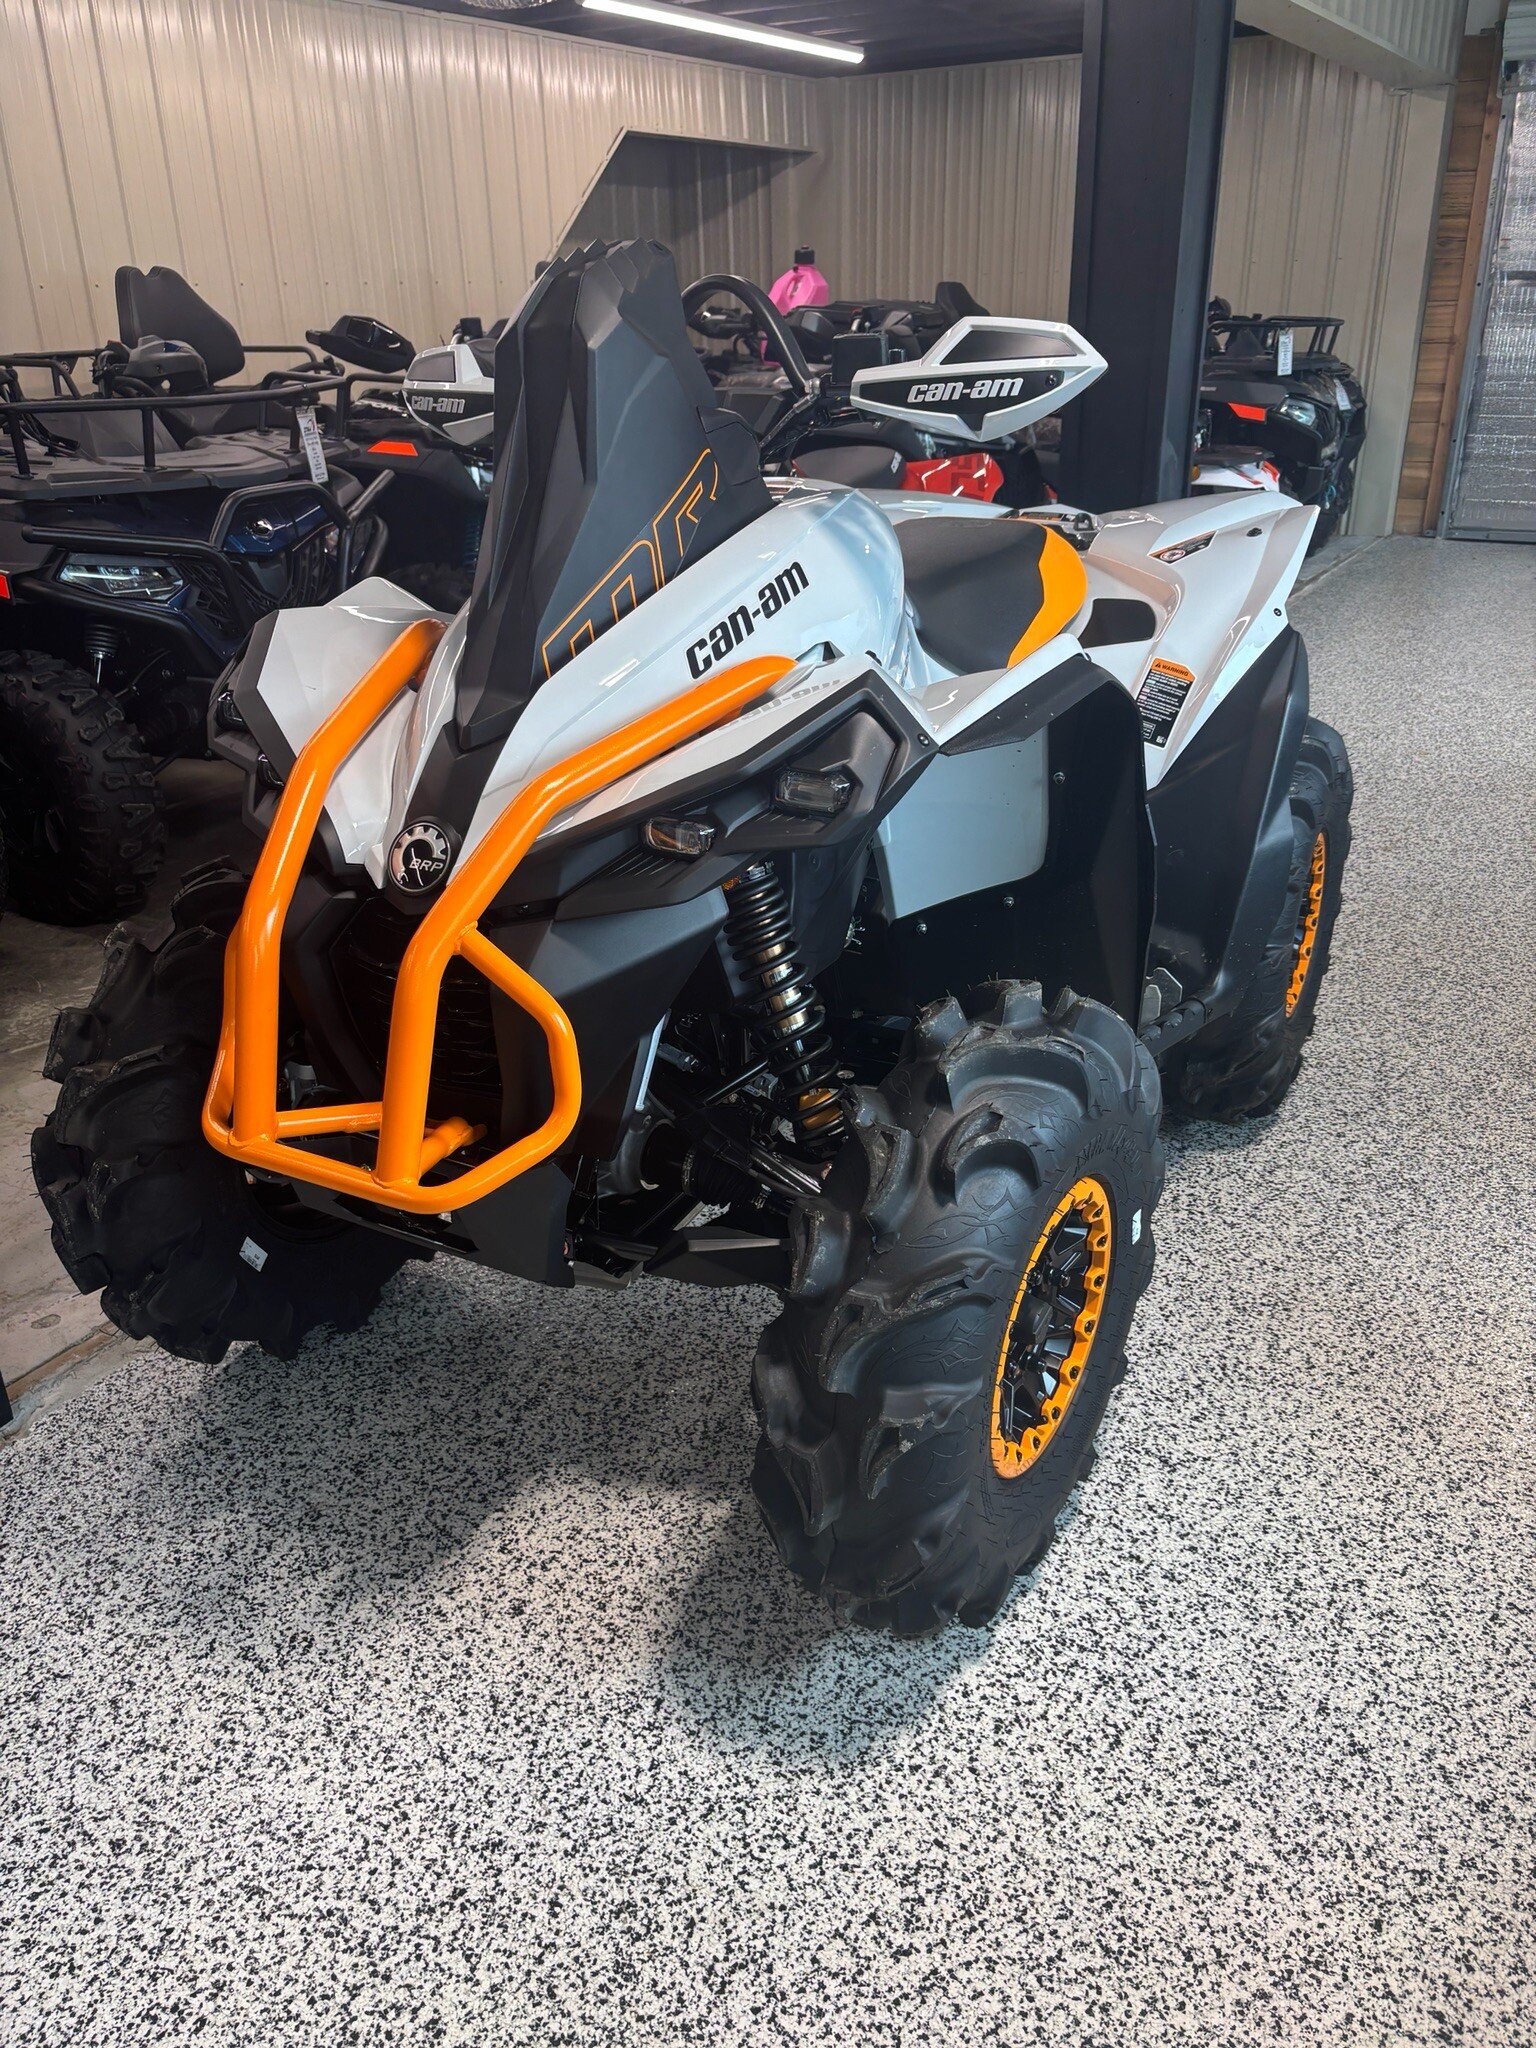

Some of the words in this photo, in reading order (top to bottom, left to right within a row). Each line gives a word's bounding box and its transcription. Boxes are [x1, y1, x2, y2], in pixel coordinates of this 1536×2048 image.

[907, 377, 1024, 404] can-am
[411, 395, 466, 414] can-am
[686, 561, 810, 680] can-am
[1161, 663, 1190, 678] WARNING
[408, 857, 445, 873] BRP
